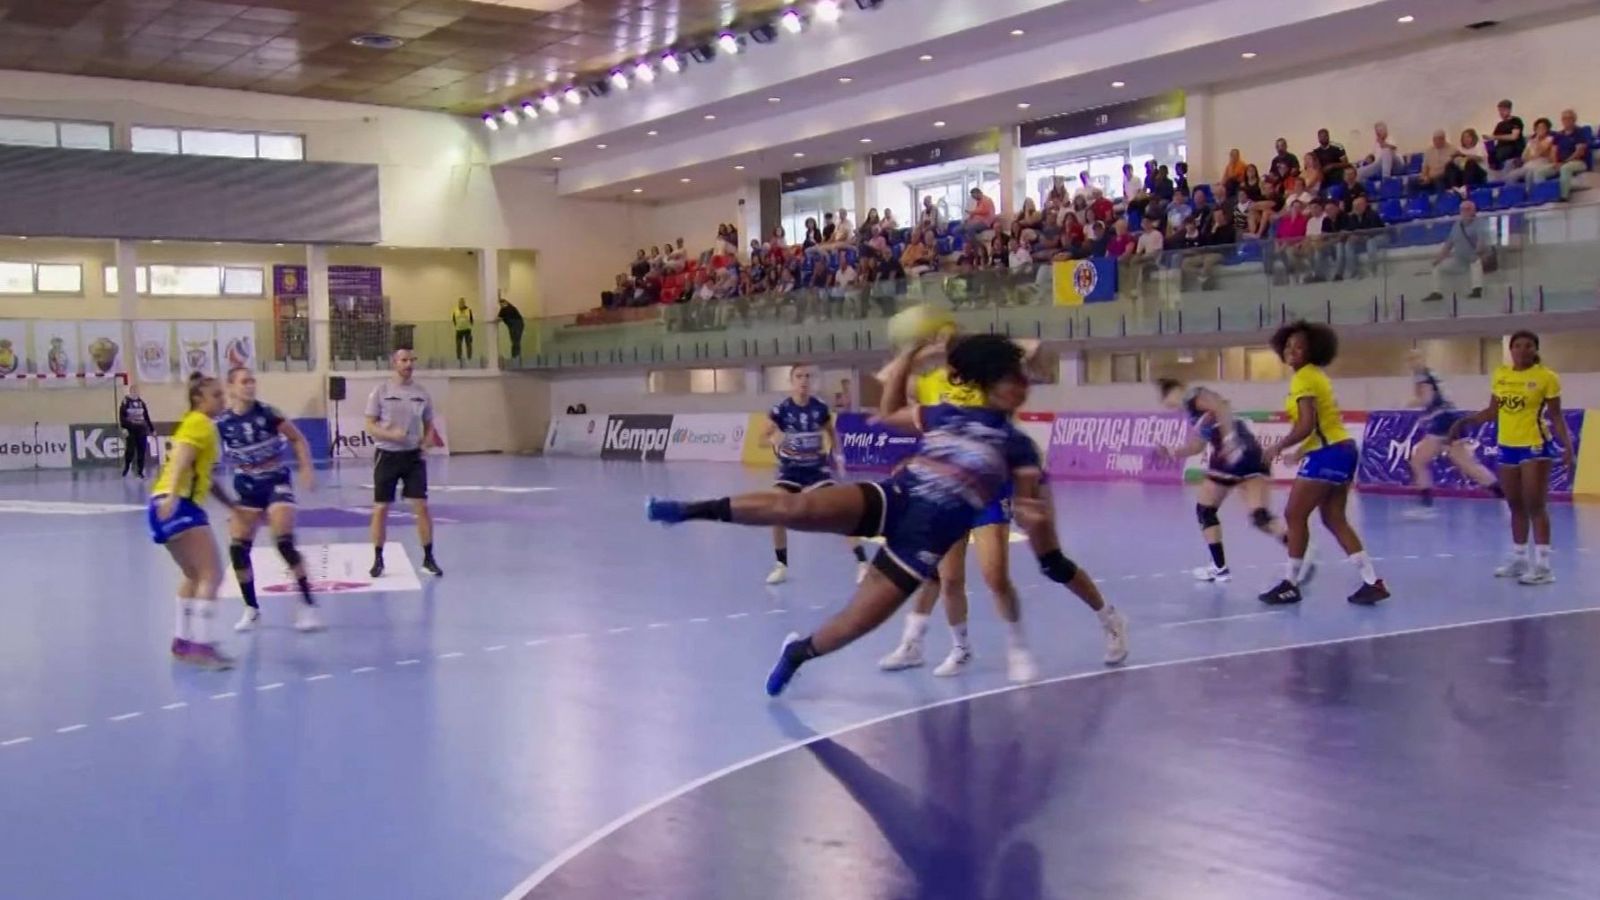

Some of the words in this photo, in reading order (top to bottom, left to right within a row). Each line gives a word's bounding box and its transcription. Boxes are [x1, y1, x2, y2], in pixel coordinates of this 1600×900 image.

[605, 418, 669, 460] Kempa
[843, 432, 873, 447] MAIA
[1052, 417, 1130, 453] SUPERTAÇA
[1131, 415, 1188, 448] IBÉRICA
